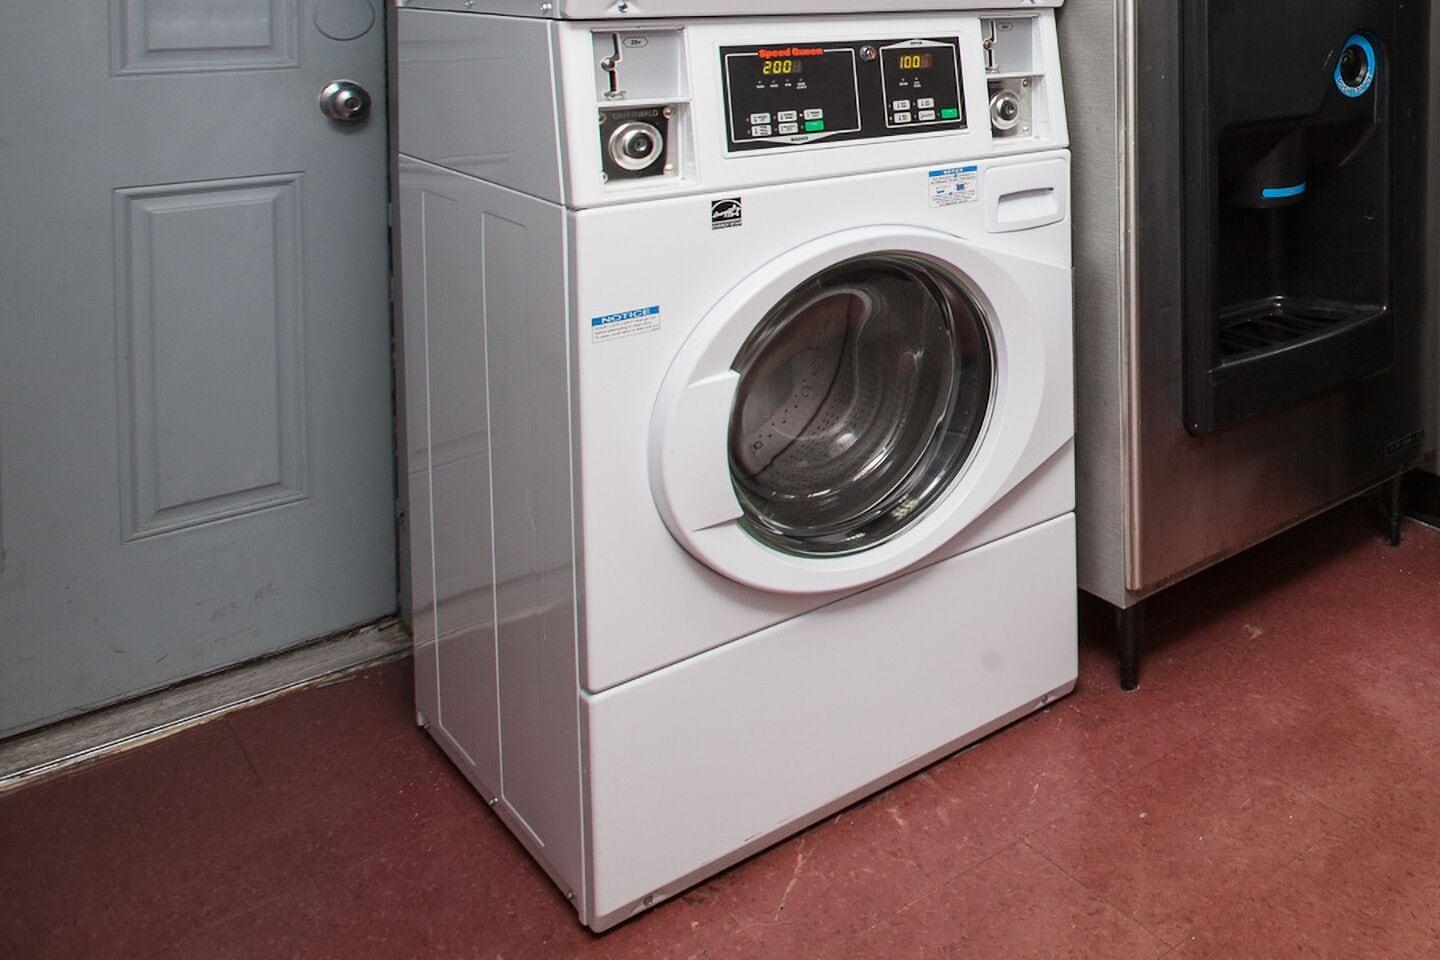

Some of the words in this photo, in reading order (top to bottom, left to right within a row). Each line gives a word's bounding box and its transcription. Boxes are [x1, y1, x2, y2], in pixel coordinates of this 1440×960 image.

[758, 47, 790, 58] Speed
[791, 47, 824, 56] Queen
[762, 60, 792, 74] 200
[899, 55, 920, 69] 100
[601, 309, 650, 324] NOTICE
